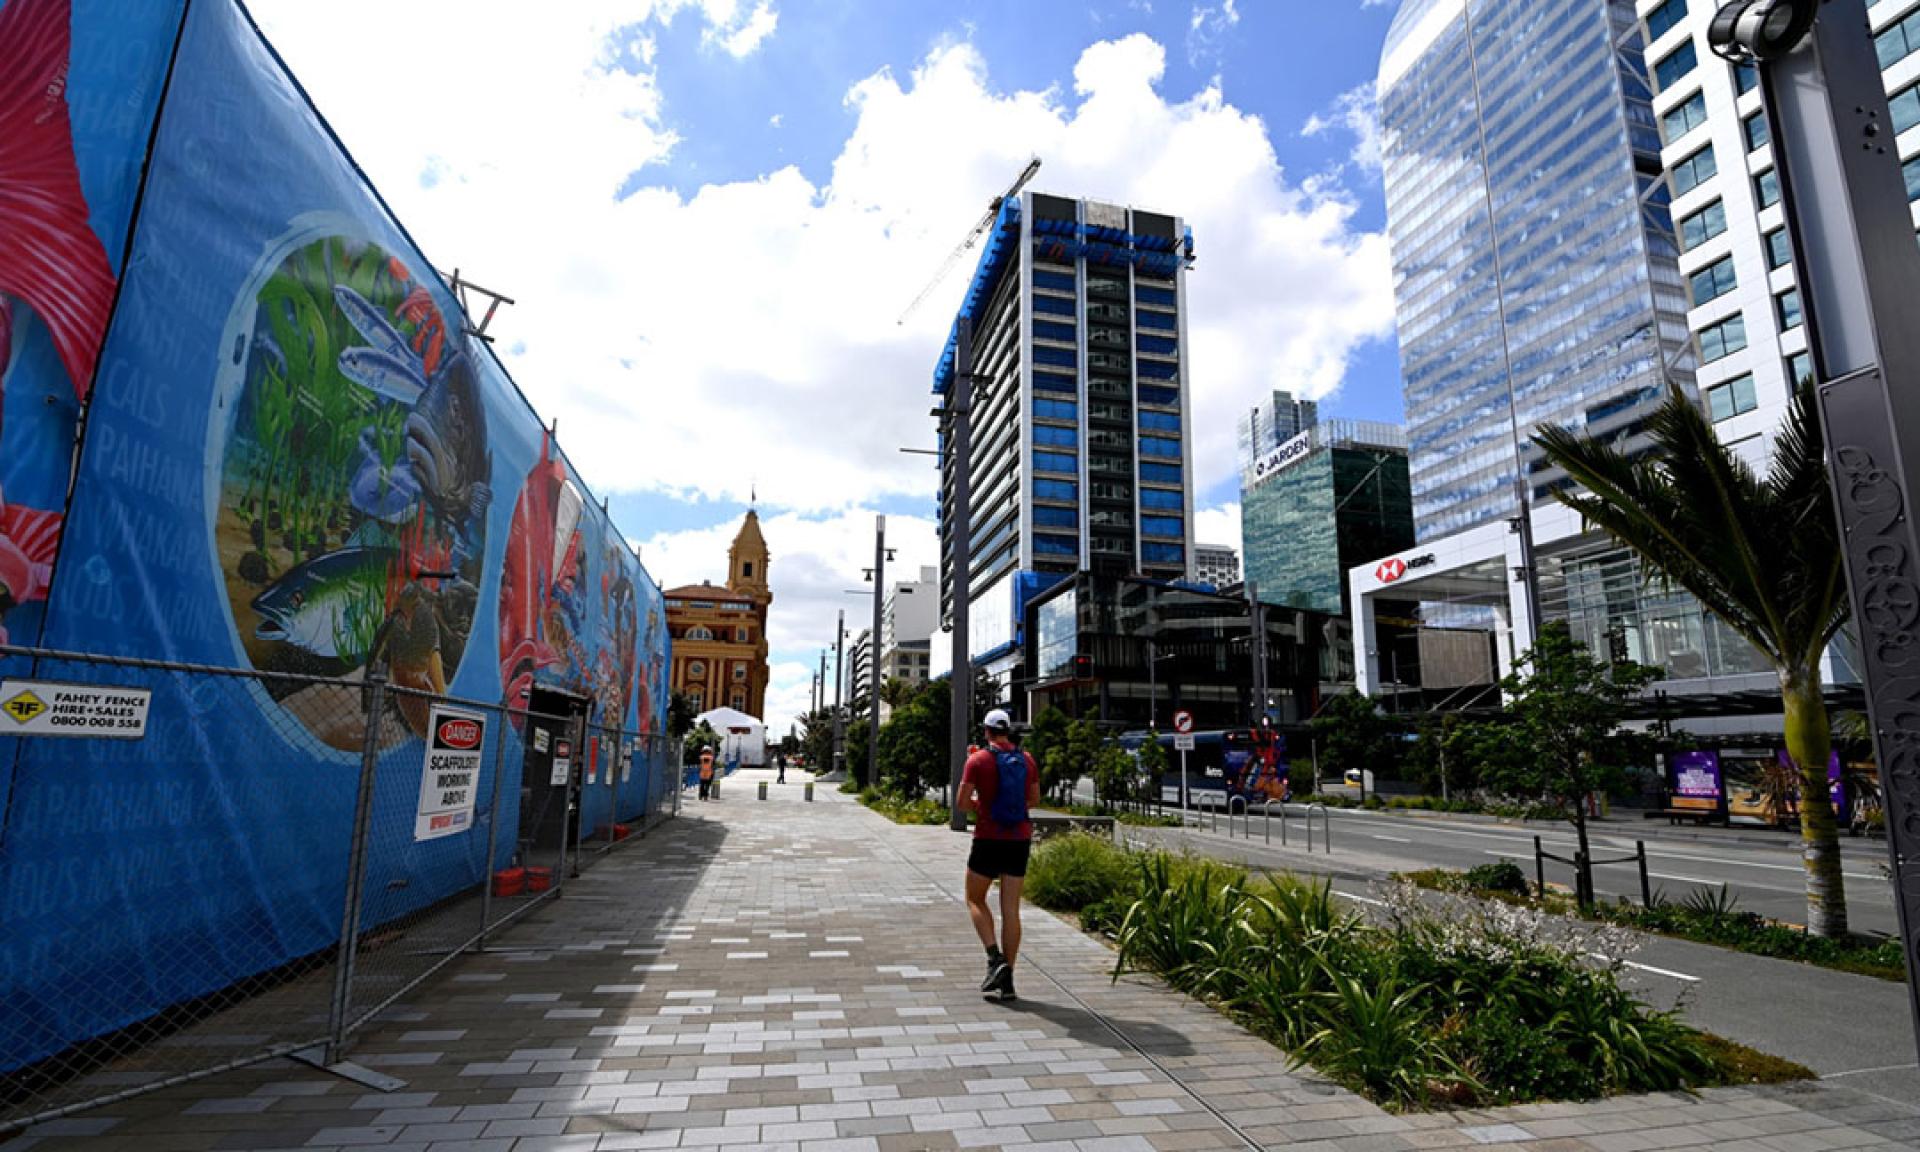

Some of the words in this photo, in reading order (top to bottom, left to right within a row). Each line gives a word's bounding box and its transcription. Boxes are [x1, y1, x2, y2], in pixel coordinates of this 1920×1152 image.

[1267, 436, 1308, 470] JARDEN
[1407, 552, 1435, 570] HSBC
[55, 692, 101, 705] FAHEY
[105, 696, 145, 707] FENCE
[51, 715, 86, 726] 0800
[89, 717, 115, 727] 008
[445, 723, 477, 741] DANGER
[441, 790, 467, 806] ABOVE
